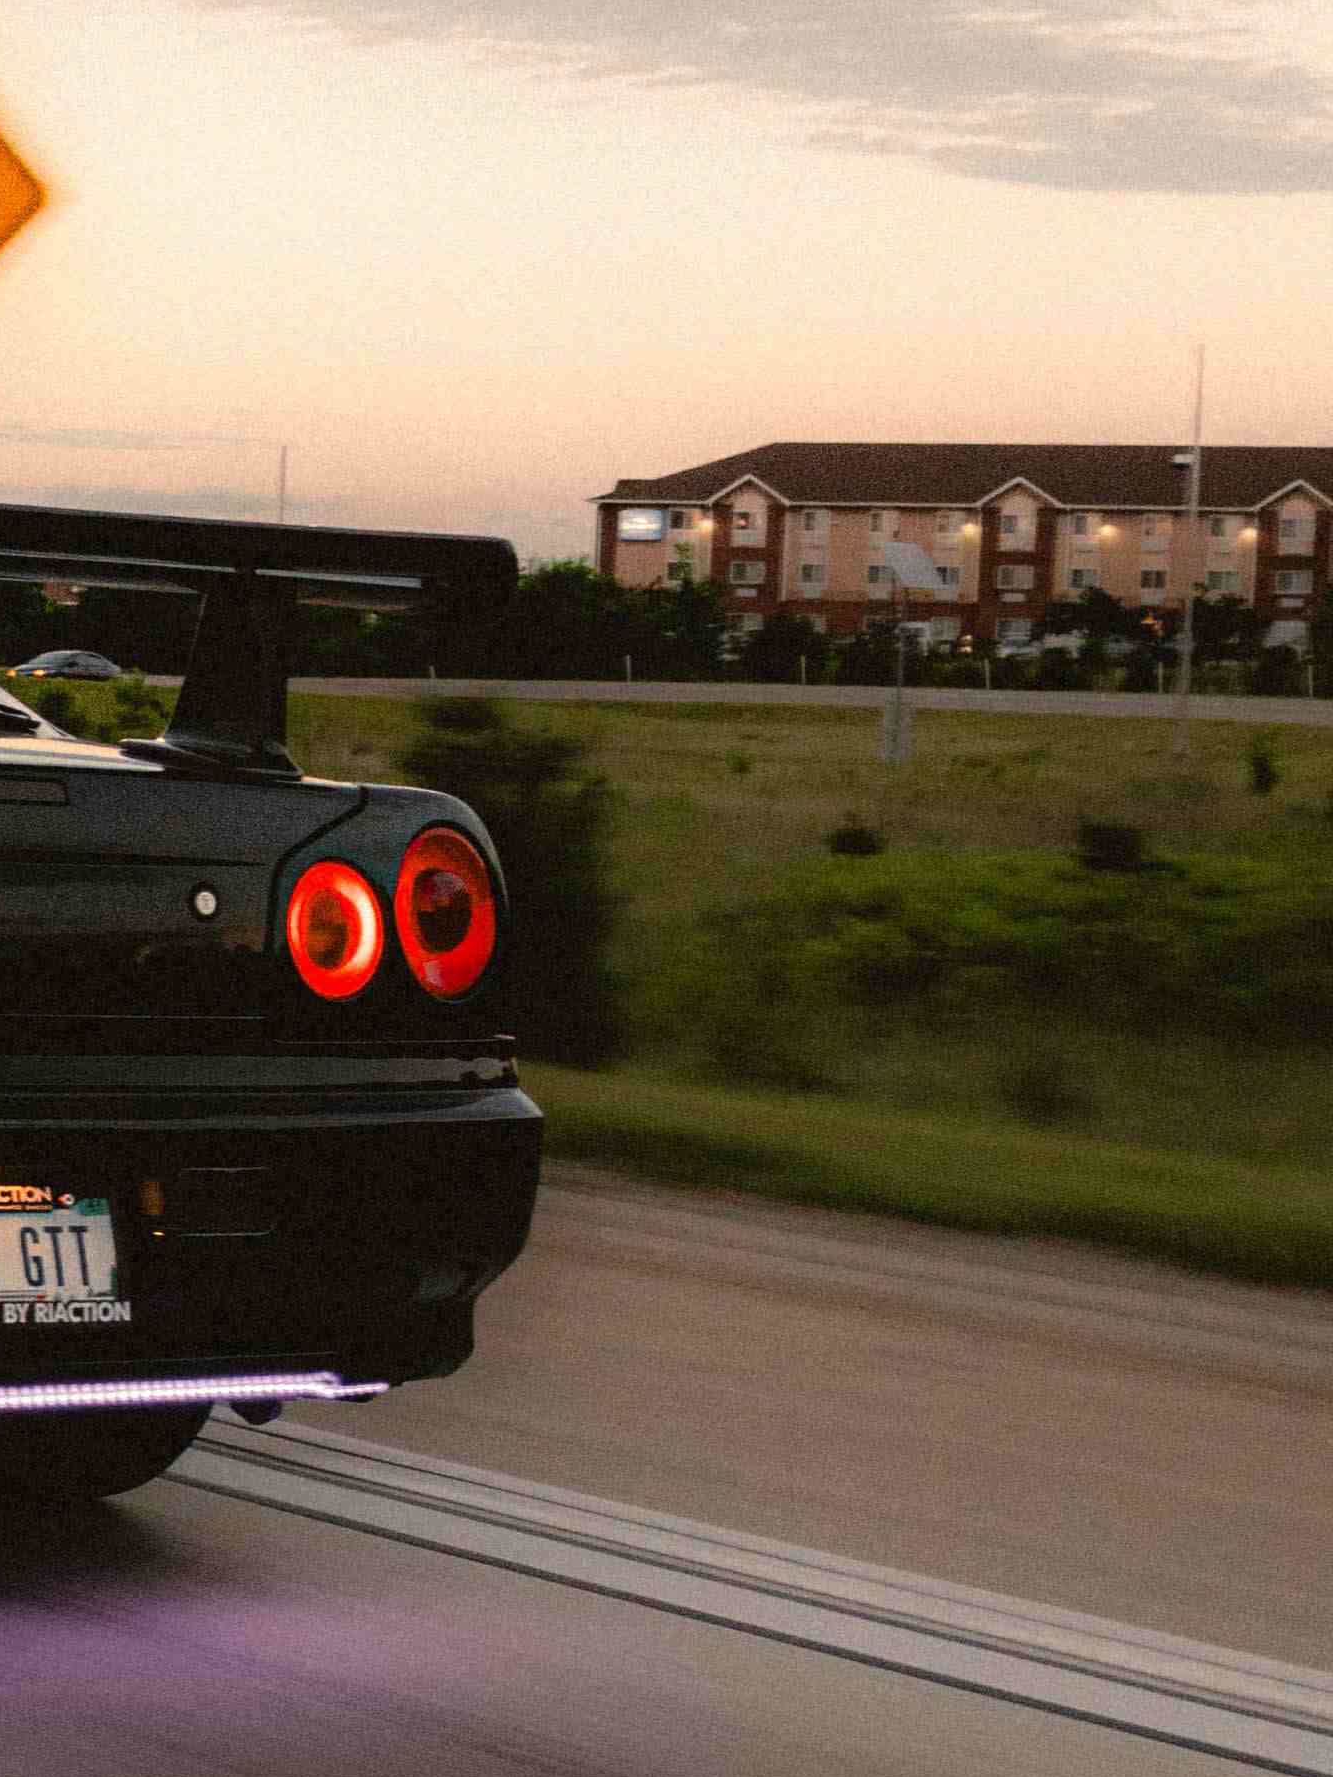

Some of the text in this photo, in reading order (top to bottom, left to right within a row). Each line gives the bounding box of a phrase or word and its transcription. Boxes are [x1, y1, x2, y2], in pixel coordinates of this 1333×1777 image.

[19, 1225, 90, 1288] GTT
[4, 1303, 30, 1323] BY
[35, 1300, 132, 1323] RIACTION
